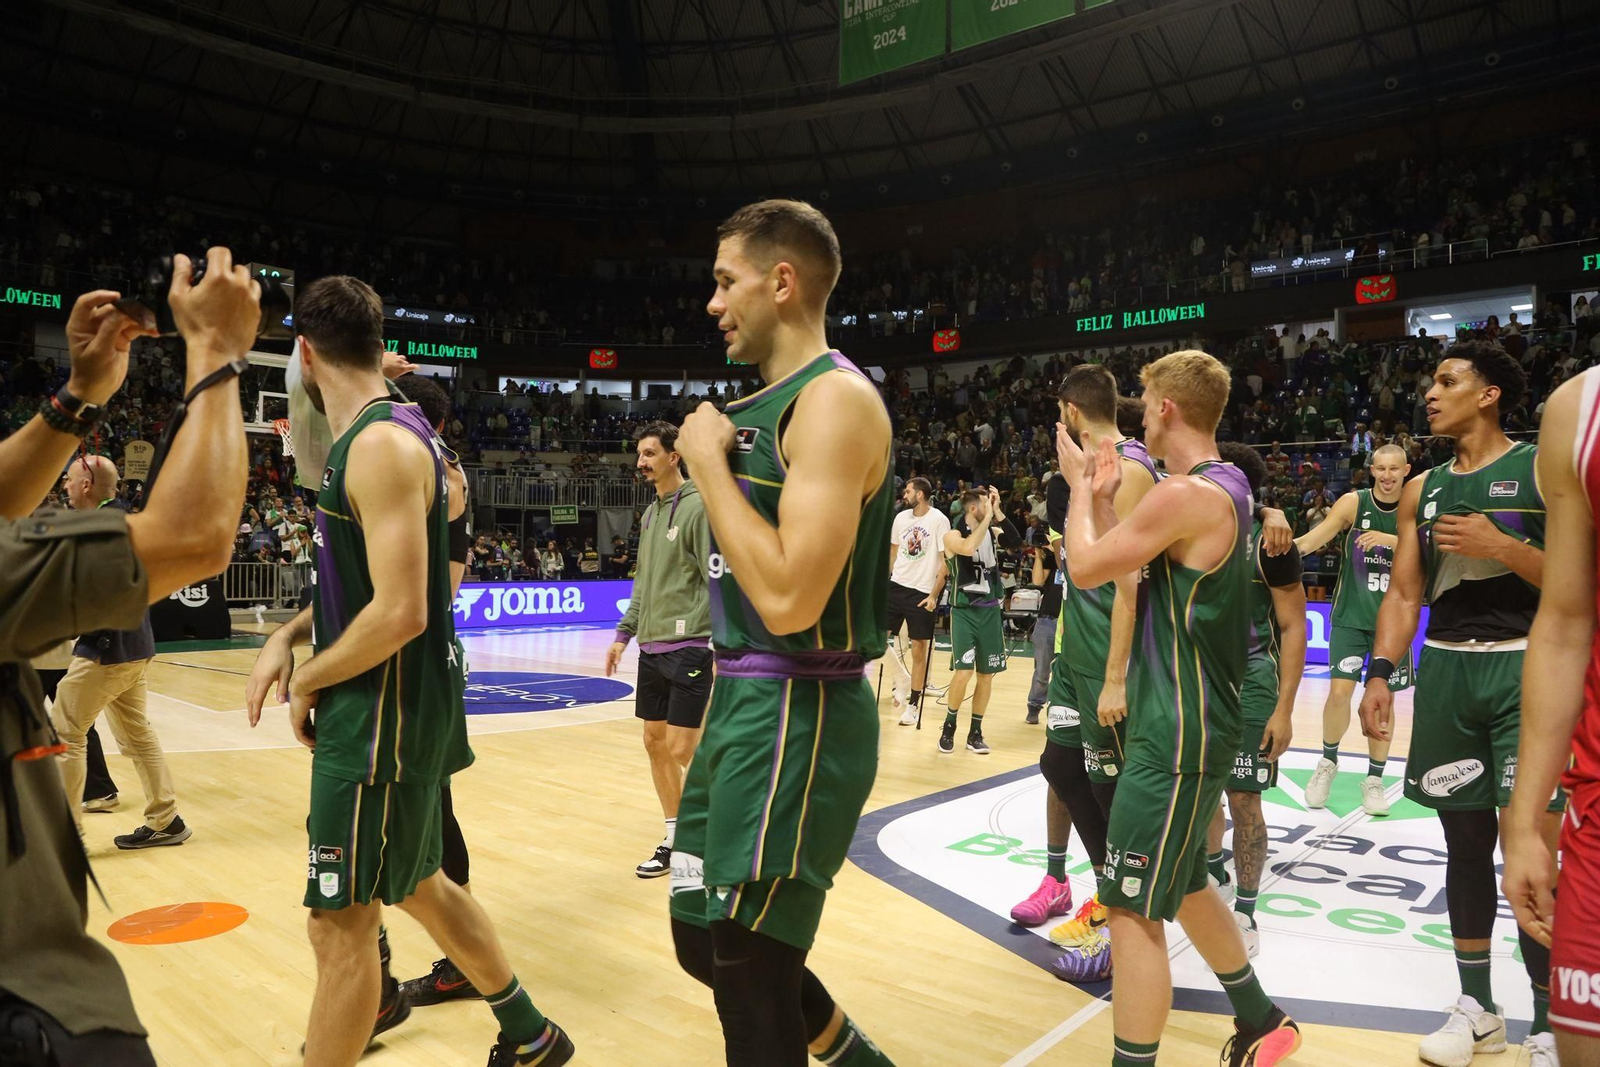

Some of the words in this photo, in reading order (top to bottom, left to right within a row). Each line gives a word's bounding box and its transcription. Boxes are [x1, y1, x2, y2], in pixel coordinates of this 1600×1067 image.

[882, 12, 897, 23] CUP
[873, 25, 907, 50] 2024
[405, 311, 430, 322] Unicaja
[1076, 315, 1114, 332] FELIZ
[1123, 303, 1206, 329] HALLOWEEN
[407, 341, 478, 359] HALLOWEEN
[1367, 572, 1391, 593] 56
[1230, 767, 1254, 779] aga
[320, 852, 338, 861] acb
[1126, 858, 1143, 867] acb
